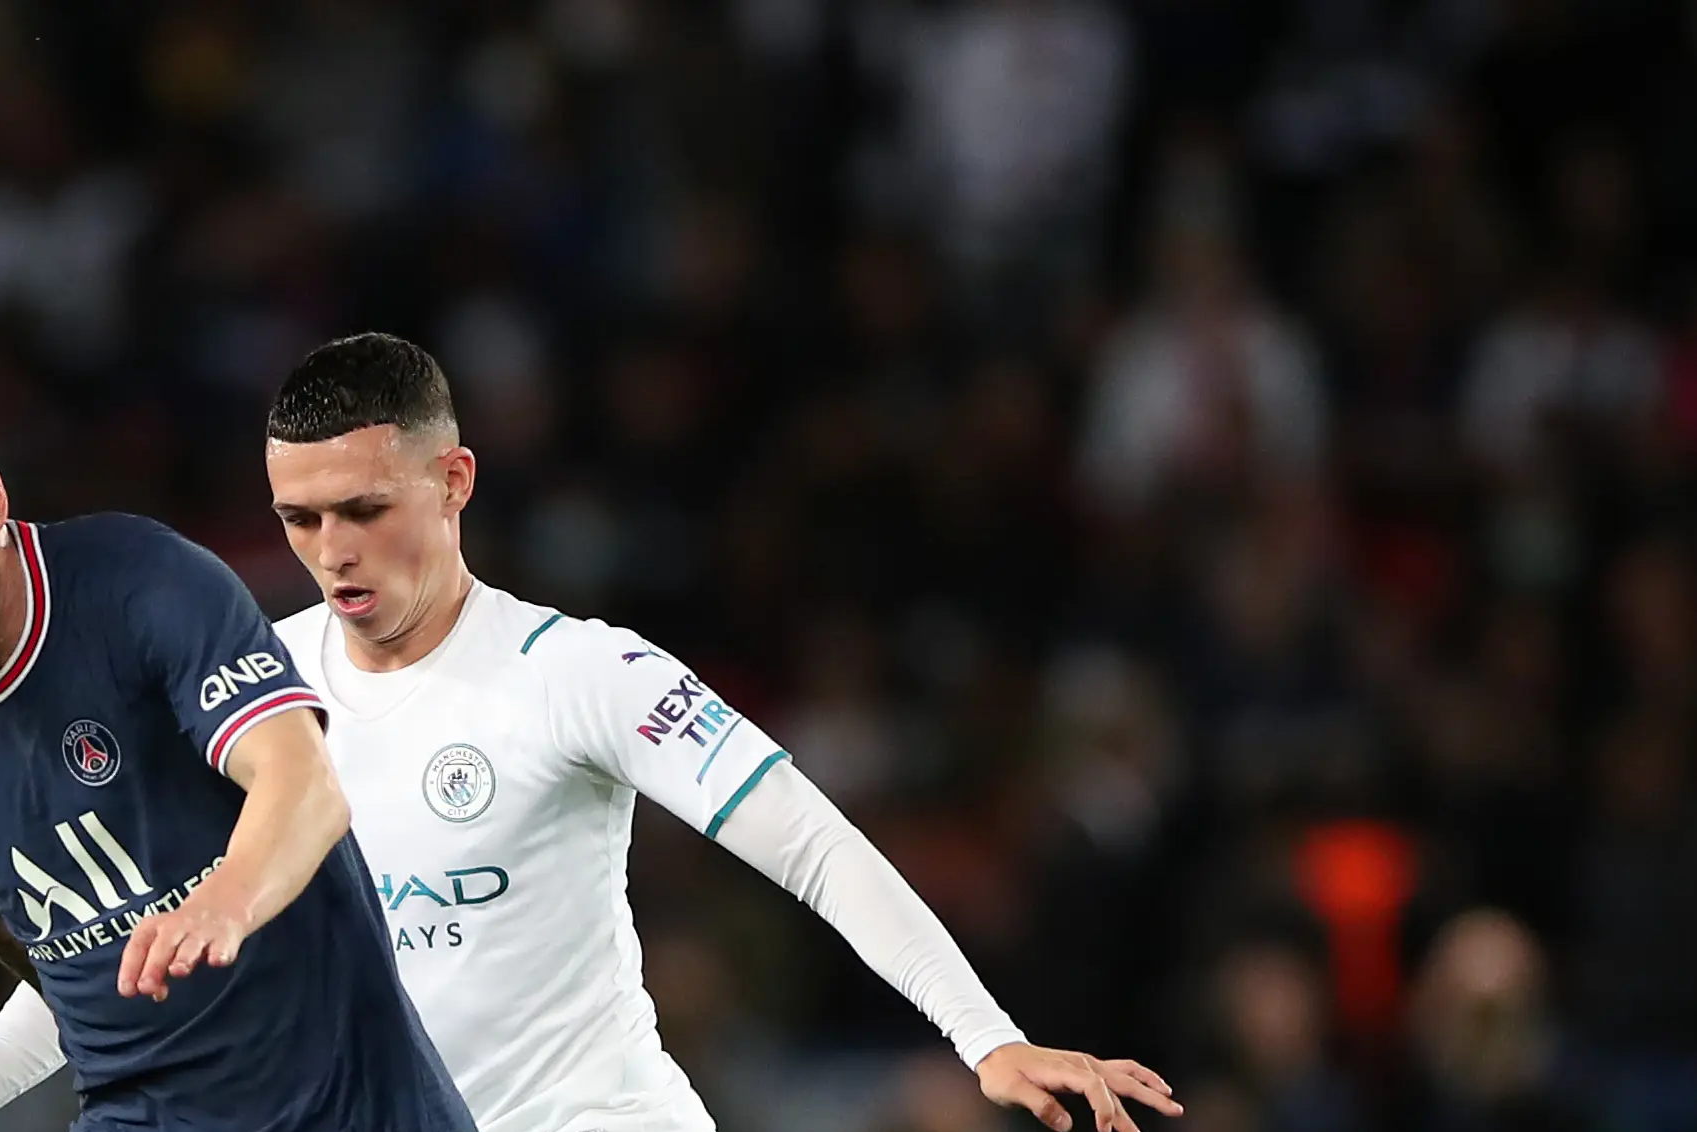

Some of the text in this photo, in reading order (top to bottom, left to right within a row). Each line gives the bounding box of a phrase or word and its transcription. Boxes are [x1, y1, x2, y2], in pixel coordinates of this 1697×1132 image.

[200, 652, 285, 711] QNB
[65, 723, 97, 747] PARIS
[432, 750, 487, 773] MANCHESTER
[447, 808, 469, 817] CITY
[53, 922, 114, 960] LIVE
